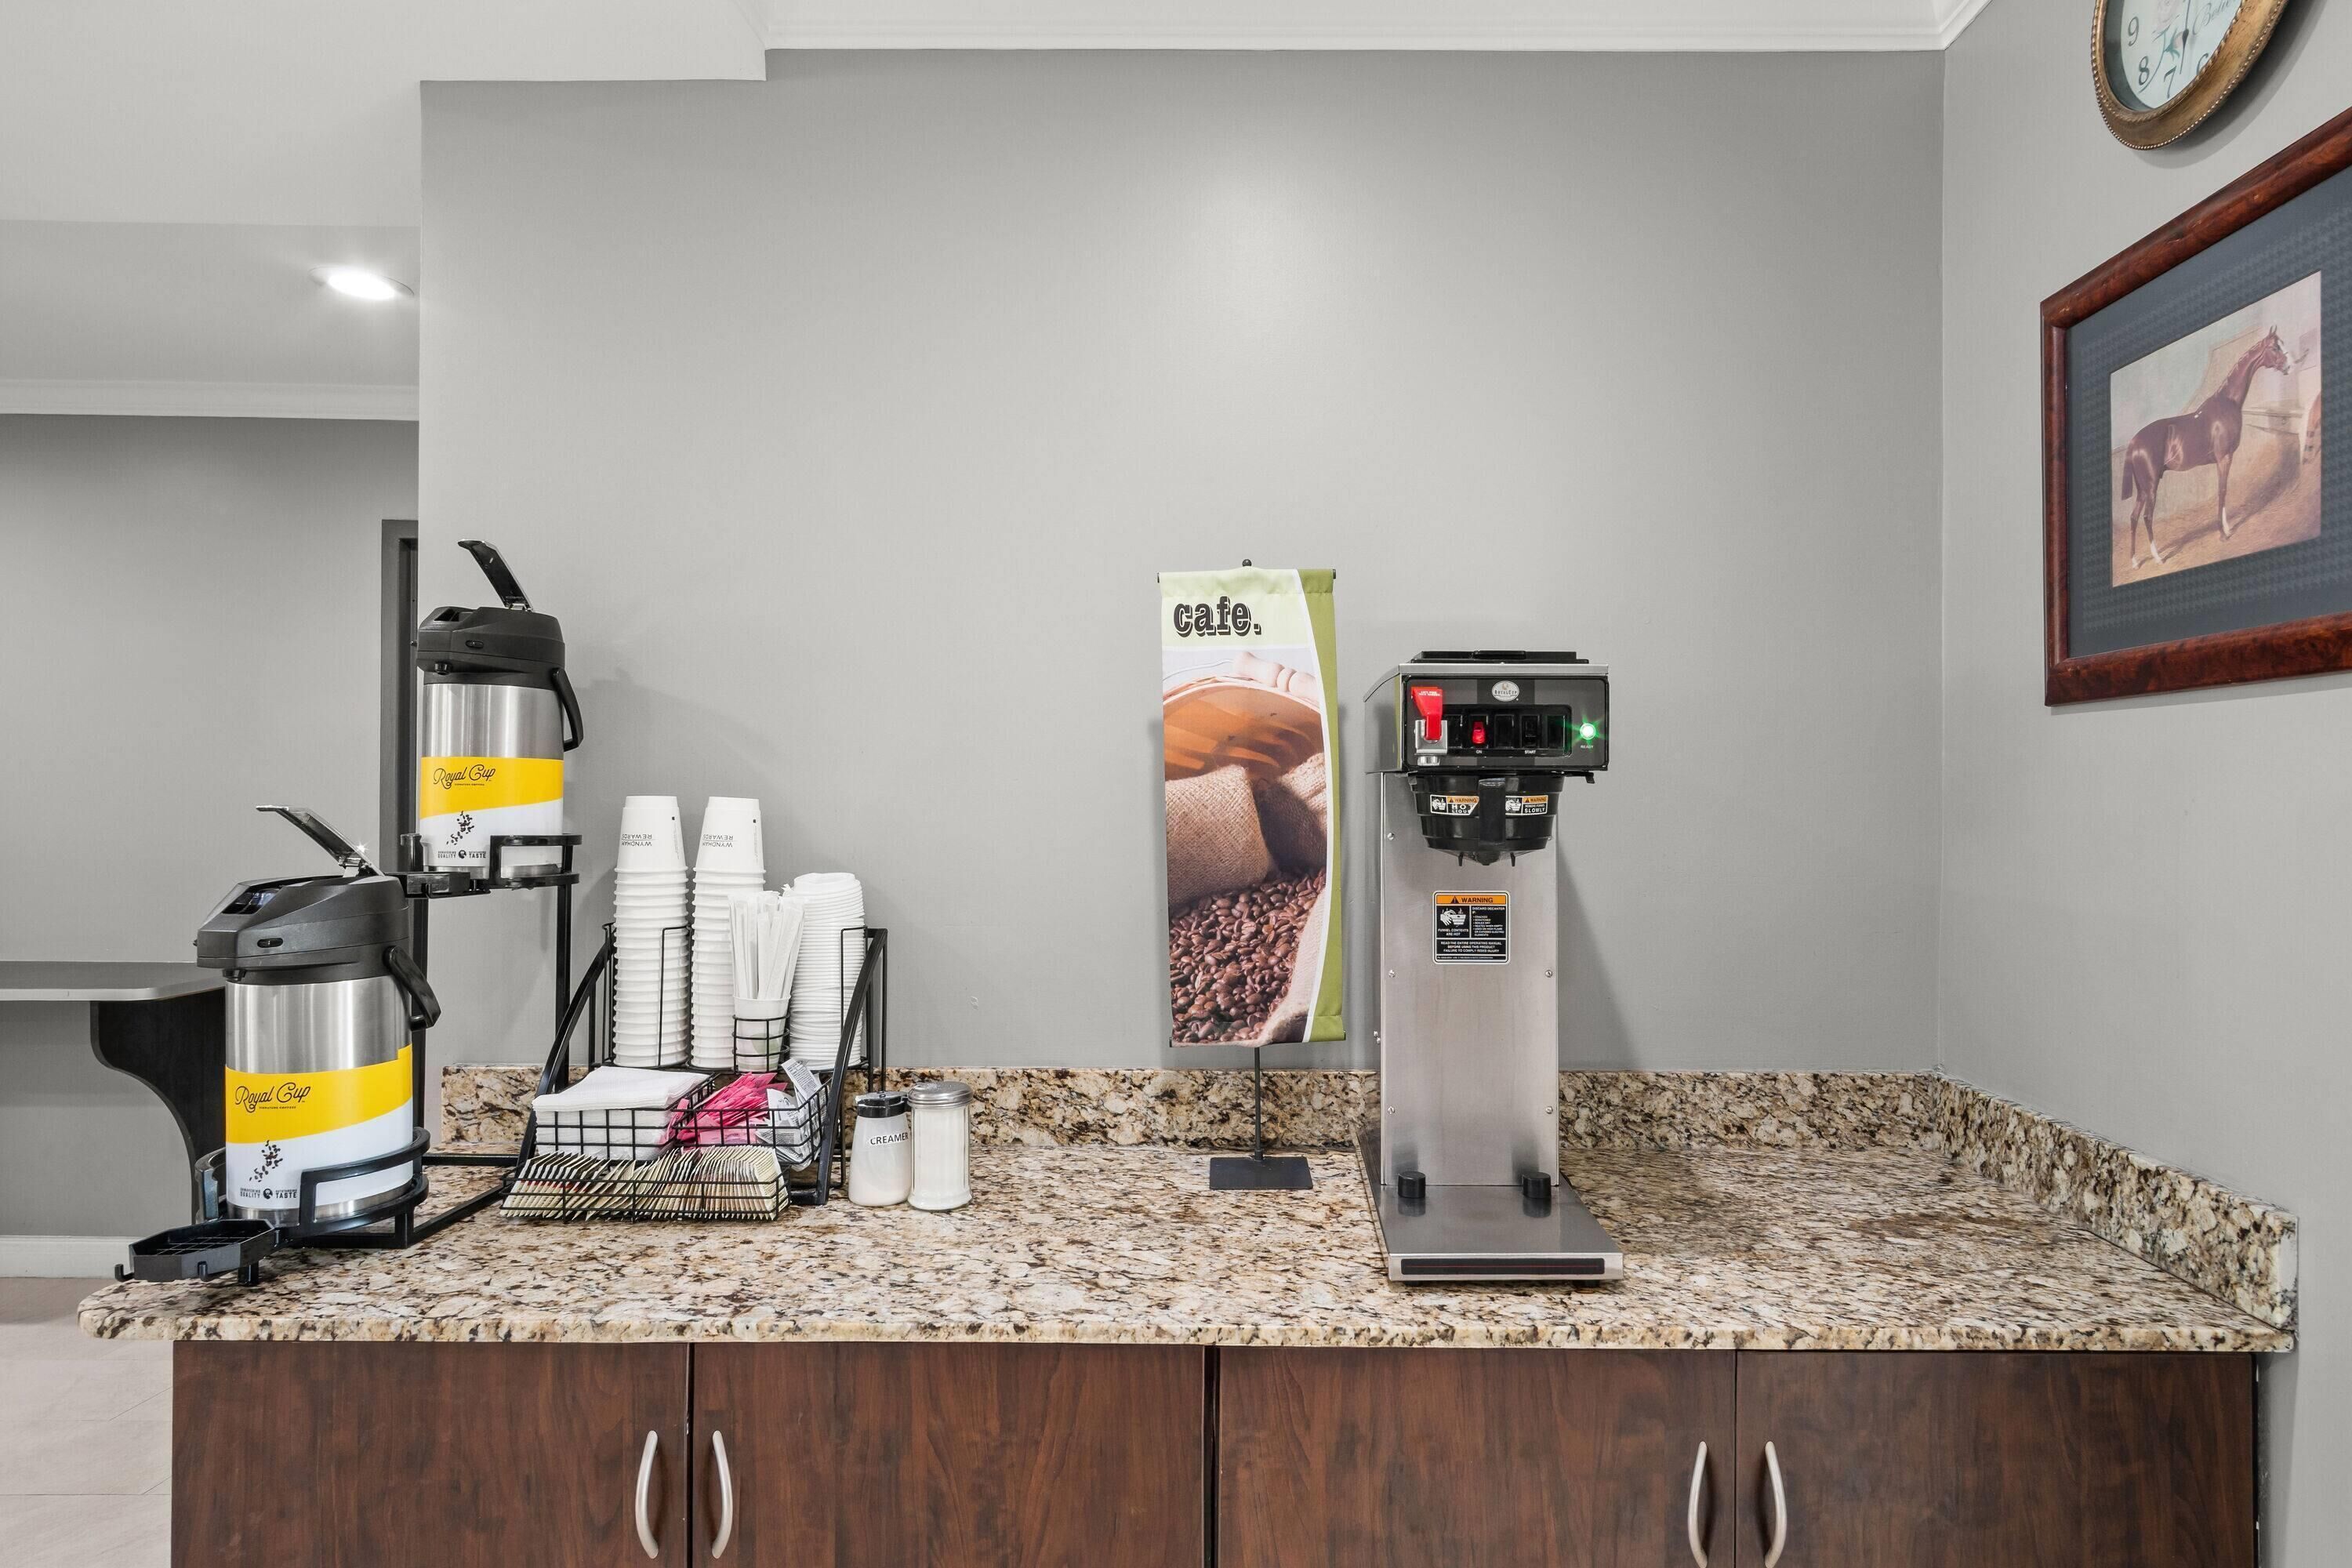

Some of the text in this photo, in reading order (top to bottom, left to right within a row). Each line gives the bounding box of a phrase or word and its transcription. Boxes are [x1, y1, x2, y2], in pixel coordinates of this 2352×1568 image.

[2128, 16, 2140, 47] 9
[2138, 56, 2150, 85] 8
[2163, 65, 2177, 99] 7
[1173, 596, 1262, 637] cafe.
[434, 764, 496, 789] Royal Cup
[235, 1082, 311, 1113] Royal Cup
[870, 1132, 909, 1145] CREAMER
